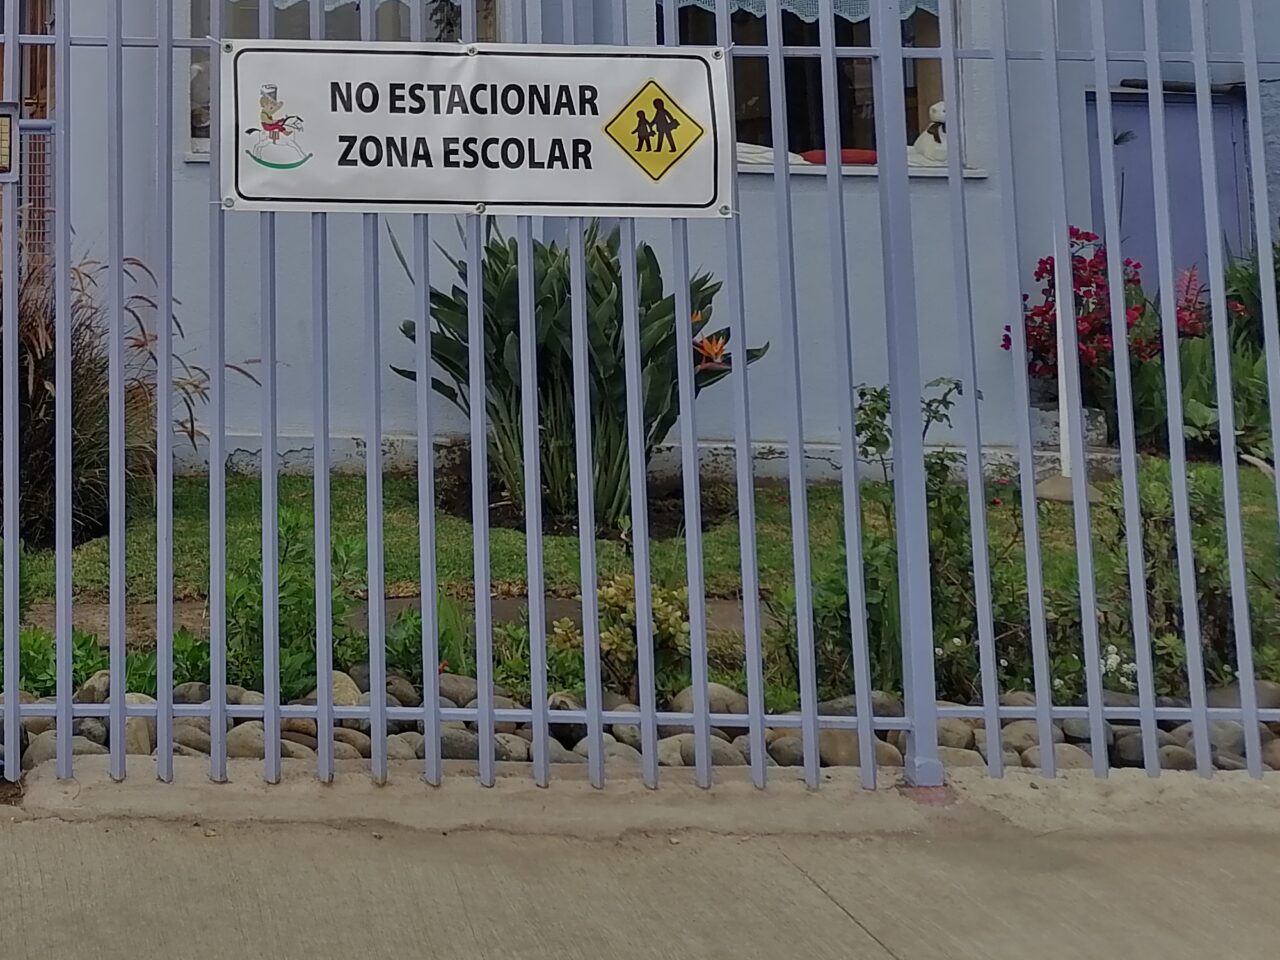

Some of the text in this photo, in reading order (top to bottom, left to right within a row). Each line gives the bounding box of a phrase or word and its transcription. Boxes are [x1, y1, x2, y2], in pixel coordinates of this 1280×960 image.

[330, 81, 599, 116] NO ESTACIONAR
[337, 135, 593, 170] ZONA ESCOLAR
